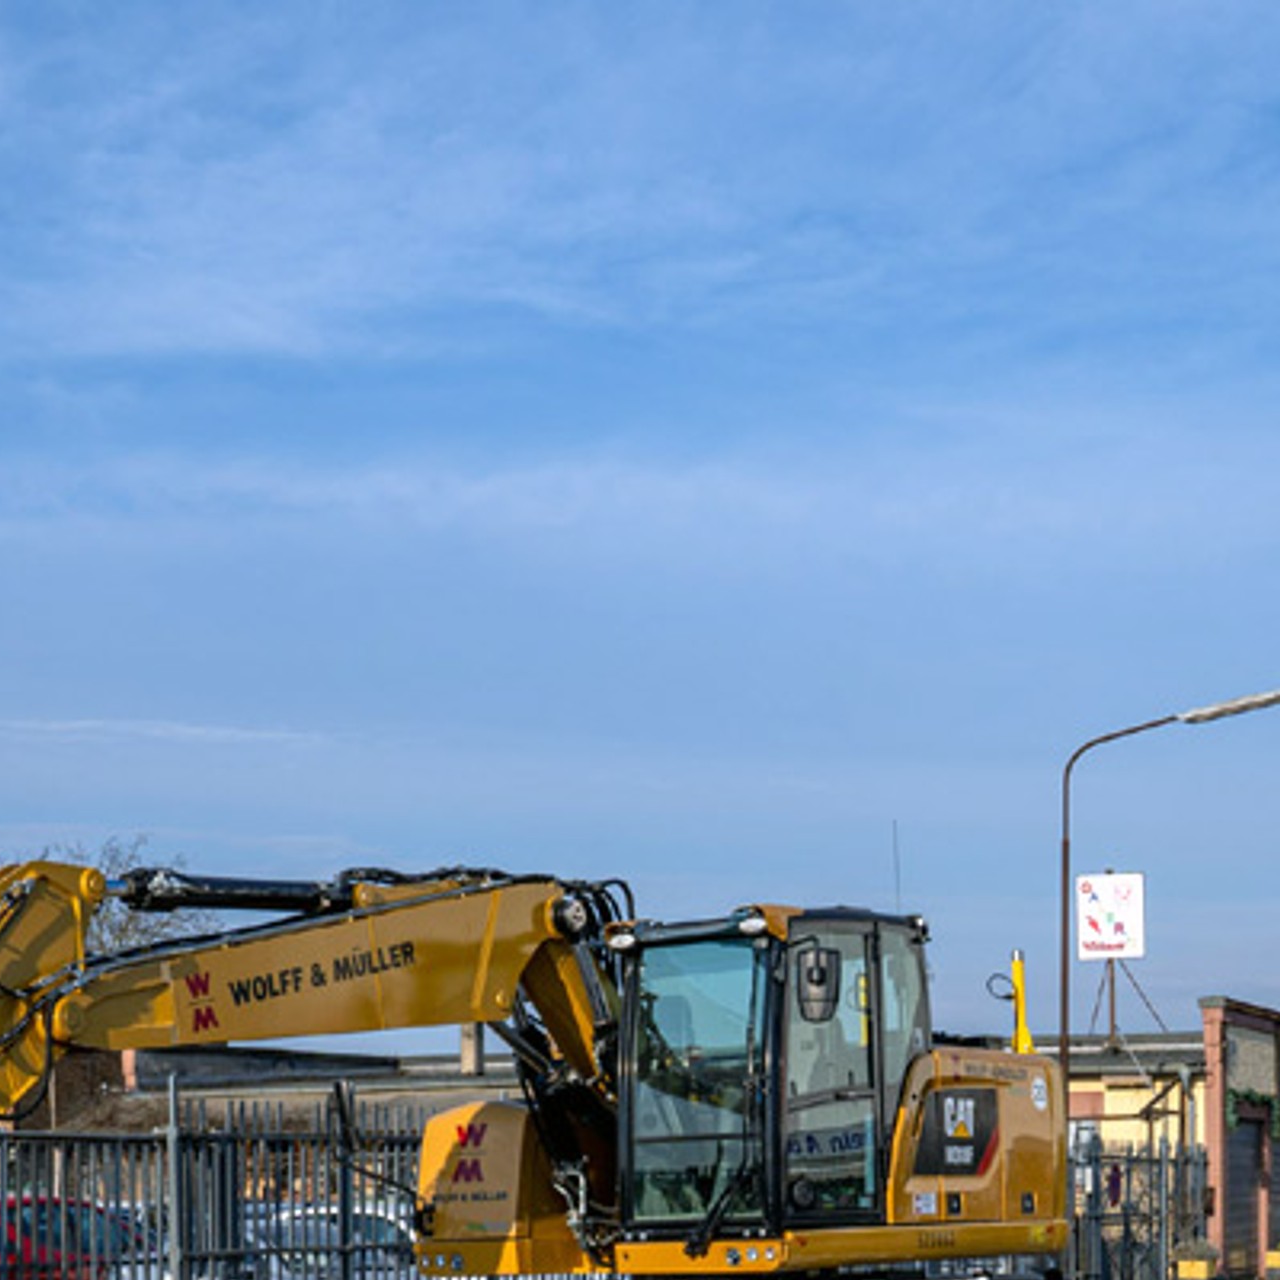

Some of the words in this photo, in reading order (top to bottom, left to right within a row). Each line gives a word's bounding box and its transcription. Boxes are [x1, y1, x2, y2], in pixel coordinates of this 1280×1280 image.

[228, 967, 302, 1006] WOLFF
[311, 963, 326, 987] &
[333, 941, 416, 982] MÜLLER
[944, 1097, 975, 1138] CAT
